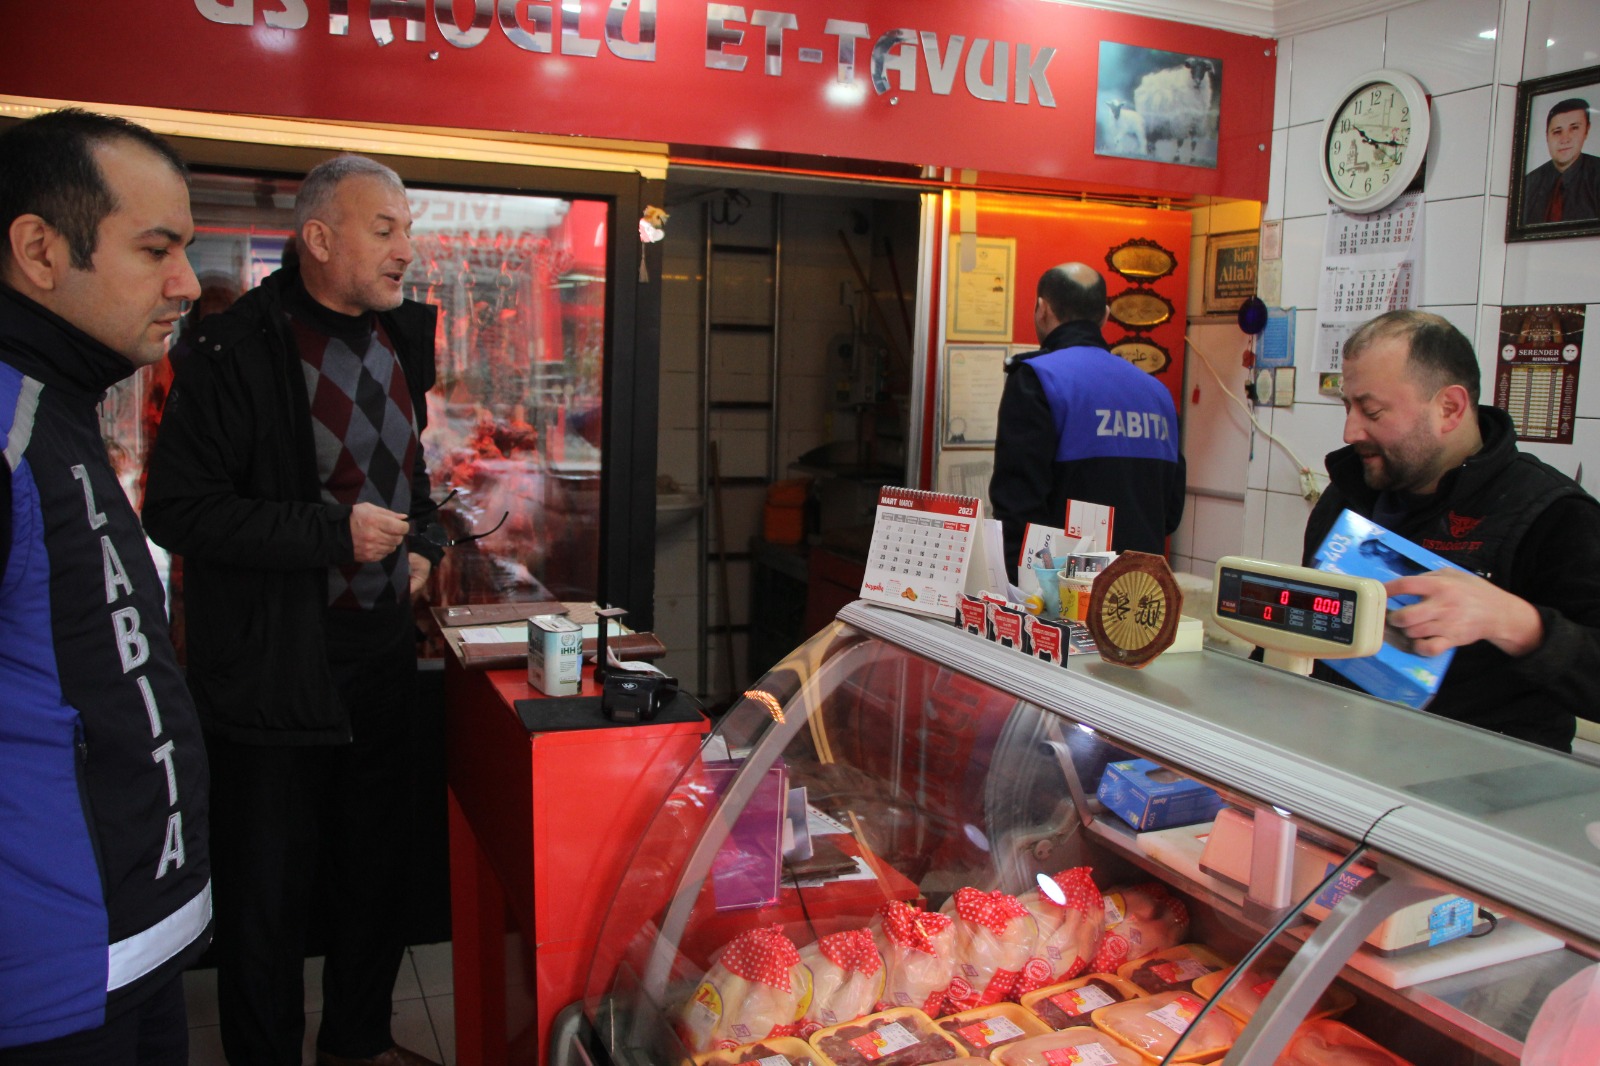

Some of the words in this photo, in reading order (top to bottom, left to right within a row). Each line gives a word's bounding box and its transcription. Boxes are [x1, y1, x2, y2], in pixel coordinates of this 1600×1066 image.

[705, 3, 1057, 108] ET-TAVUK
[1370, 90, 1382, 106] 12
[1390, 93, 1394, 108] 1
[1354, 101, 1362, 115] 11
[1401, 107, 1409, 122] 2
[1341, 119, 1351, 134] 10
[1334, 141, 1341, 155] 9
[1395, 151, 1402, 165] 4
[1338, 162, 1345, 176] 8
[1383, 169, 1390, 184] 5
[1350, 171, 1356, 188] 7
[1365, 178, 1372, 192] 6
[1095, 409, 1169, 441] ZABITA
[881, 496, 897, 506] MART
[958, 507, 973, 515] 2023
[1280, 590, 1290, 605] 0
[1313, 597, 1341, 615] 0.00
[71, 464, 185, 880] ZABITA
